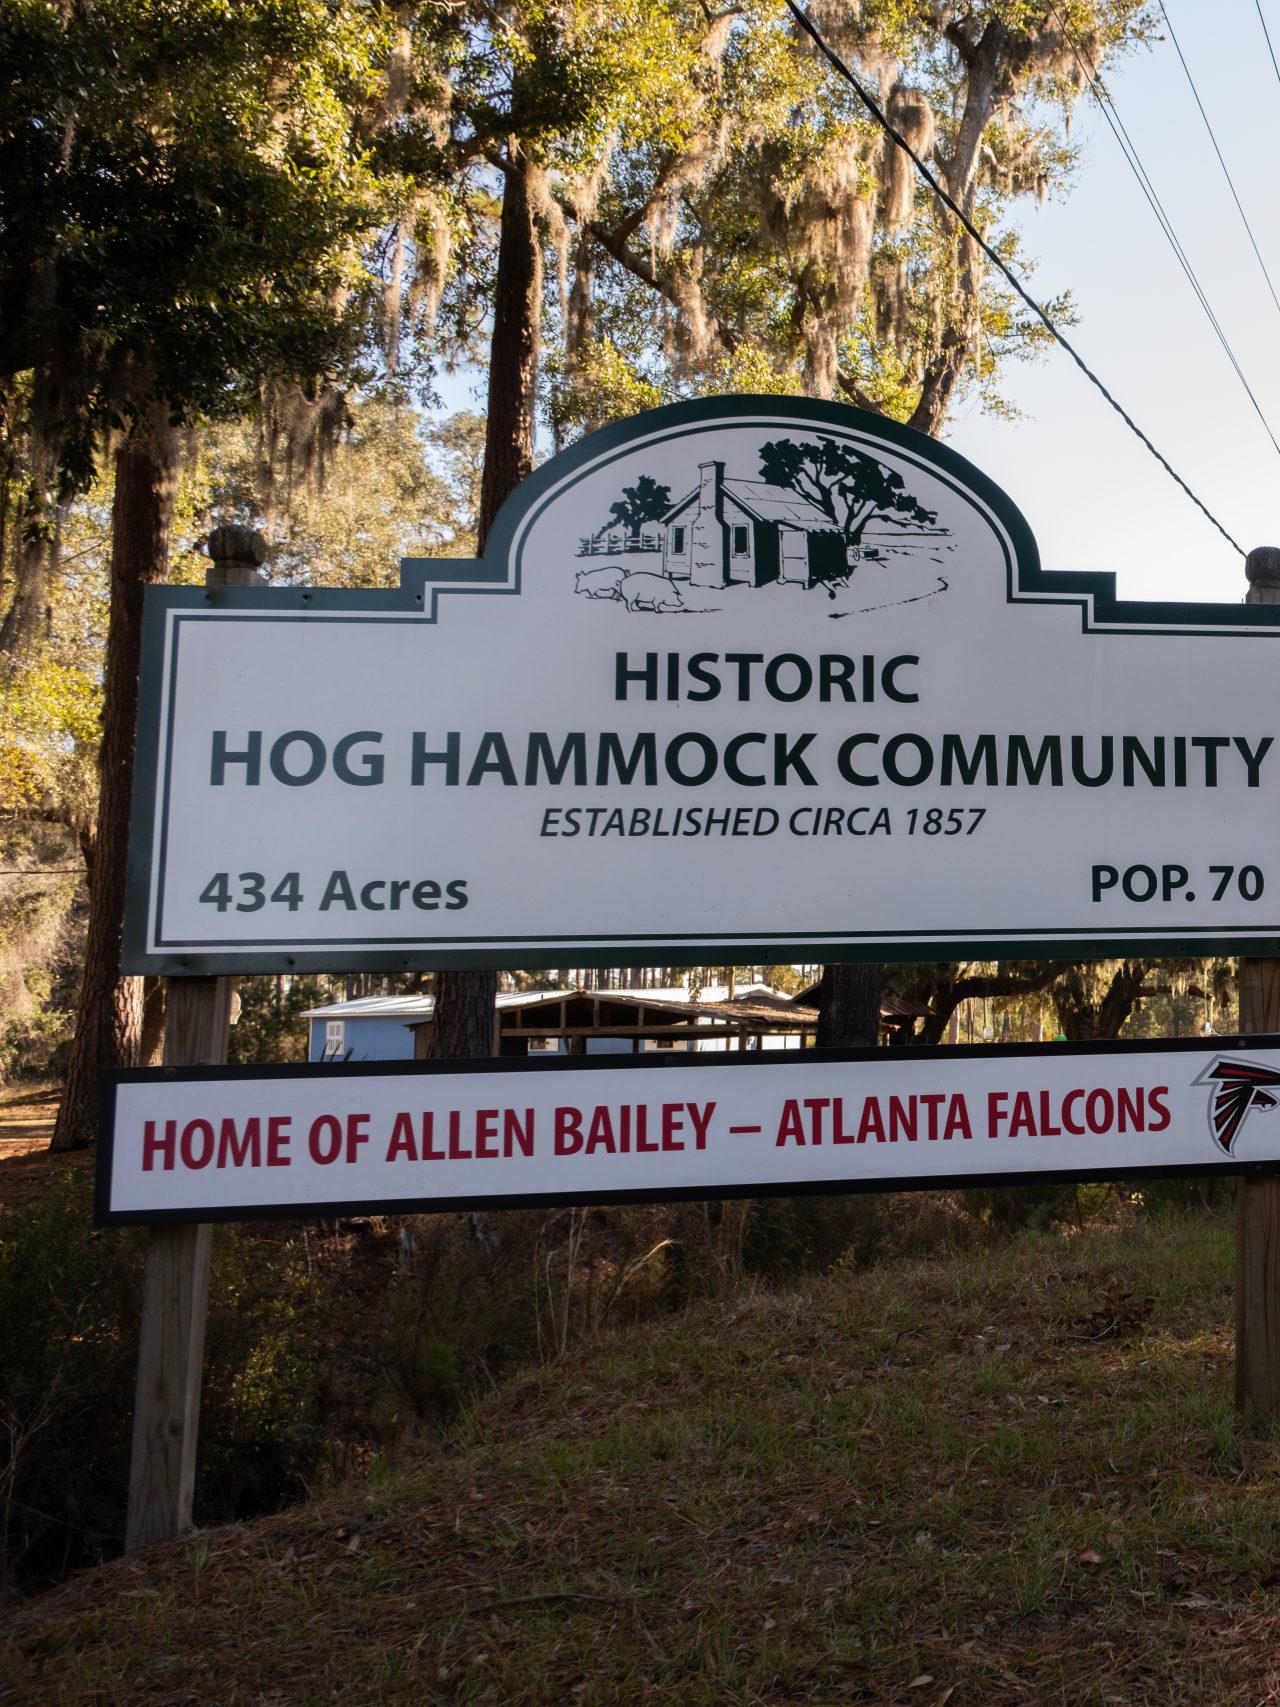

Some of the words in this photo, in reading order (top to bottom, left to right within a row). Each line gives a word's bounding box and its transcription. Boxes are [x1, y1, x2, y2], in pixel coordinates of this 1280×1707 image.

[615, 651, 920, 704] HISTORIC
[209, 730, 385, 787] HOG
[411, 731, 819, 787] HAMMOCK
[837, 732, 1275, 788] COMMUNITY
[540, 807, 780, 837] ESTABLISHED
[789, 807, 892, 837] CIRCA
[907, 807, 987, 836] 1857
[198, 871, 304, 913] 434
[318, 870, 469, 912] Acres
[1091, 864, 1196, 903] POP.
[1208, 864, 1265, 902] 70
[142, 1116, 292, 1172] HOME
[308, 1113, 371, 1166] OF
[385, 1108, 535, 1163] ALLEN
[554, 1101, 717, 1156] BAILEY
[775, 1093, 973, 1147] ATLANTA
[987, 1085, 1171, 1139] FALCONS
